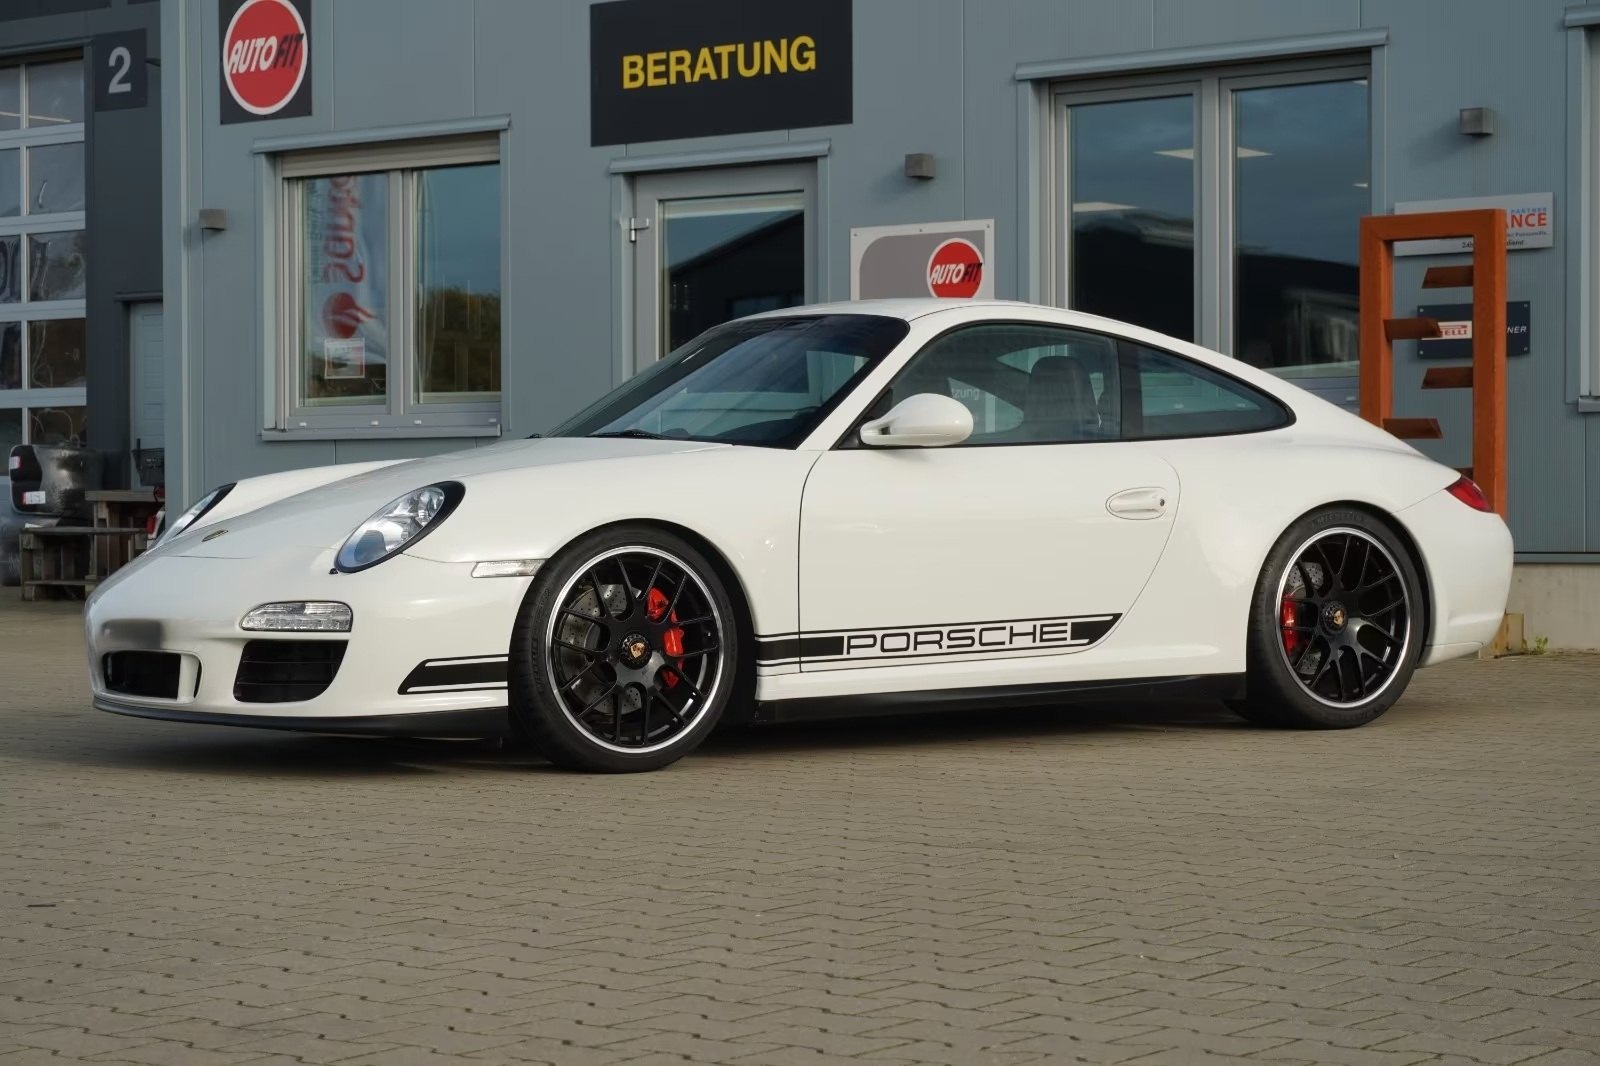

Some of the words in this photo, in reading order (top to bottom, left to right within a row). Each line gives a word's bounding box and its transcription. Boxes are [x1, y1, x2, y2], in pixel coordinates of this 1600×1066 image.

[109, 46, 131, 93] 2
[622, 35, 817, 90] BERATUNG
[1505, 212, 1547, 228] NCE
[1506, 326, 1527, 334] NER
[951, 386, 980, 401] tzung
[846, 622, 1068, 655] PORSCHE
